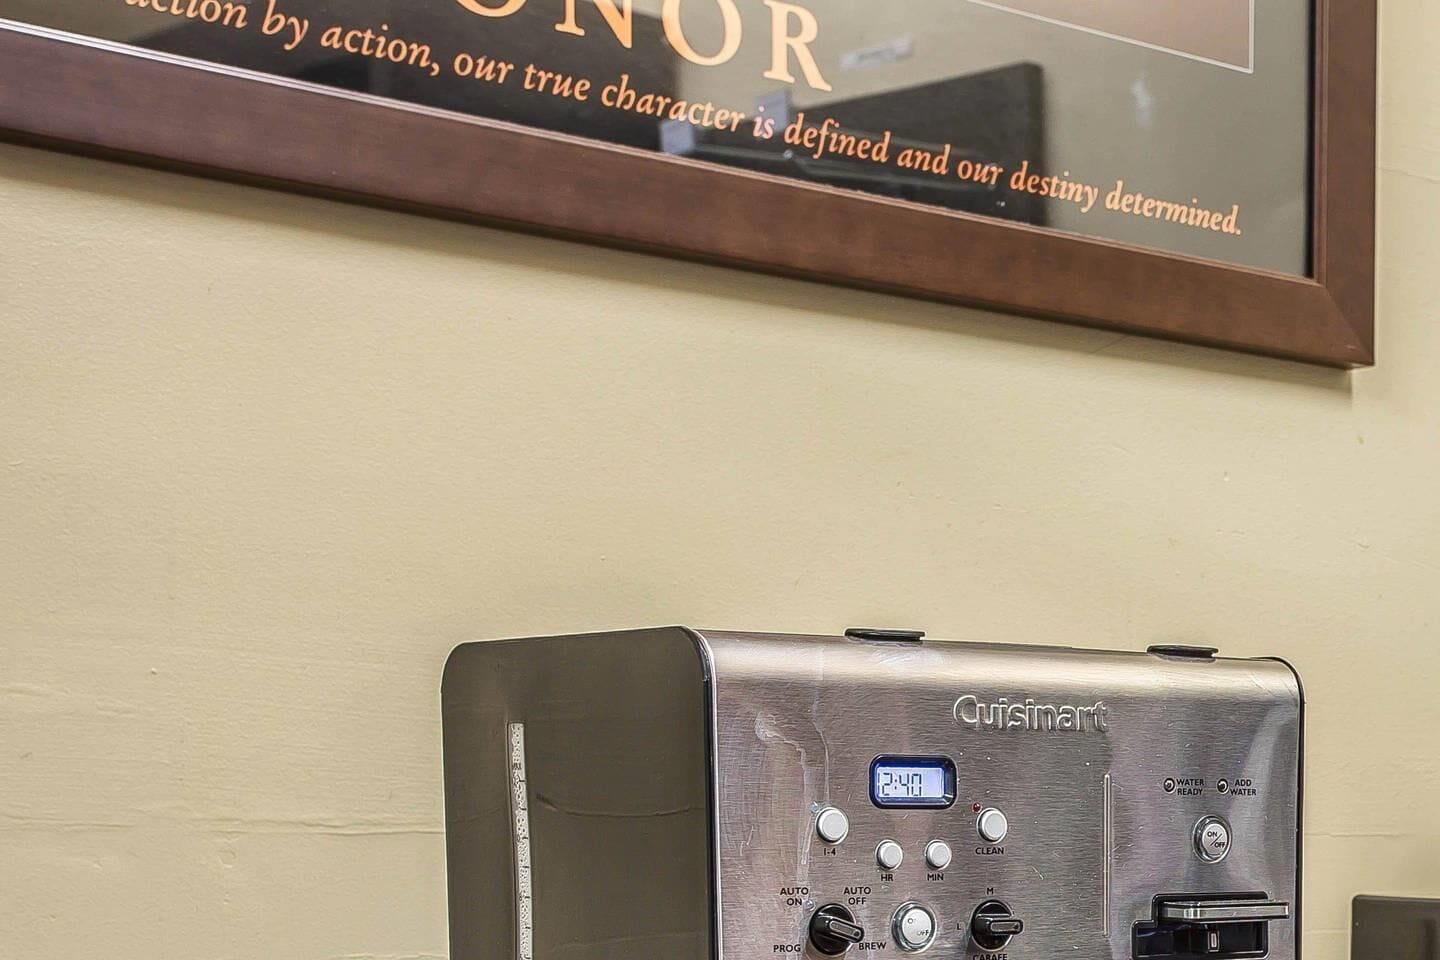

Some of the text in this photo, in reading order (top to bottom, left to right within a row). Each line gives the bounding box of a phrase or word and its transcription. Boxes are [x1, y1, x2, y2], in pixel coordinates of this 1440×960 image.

[454, 0, 833, 92] NOR
[124, 0, 1243, 236] ction by action, our true character is defined and our destiny determined.
[953, 694, 1108, 732] Cuisinart
[1176, 778, 1205, 787] WATER
[1235, 778, 1252, 787] ADD
[1177, 788, 1204, 796] READY
[1229, 788, 1257, 796] WATER
[1214, 841, 1226, 849] OFF
[975, 847, 1005, 856] CLEAN
[880, 873, 894, 882] HR
[926, 873, 944, 881] MIN
[779, 886, 809, 896] AUTO
[843, 886, 872, 895] AUTO
[986, 887, 994, 895] M
[786, 897, 803, 906] ON
[848, 897, 867, 906] OFF
[773, 943, 801, 953] PROG
[858, 941, 887, 951] BREW
